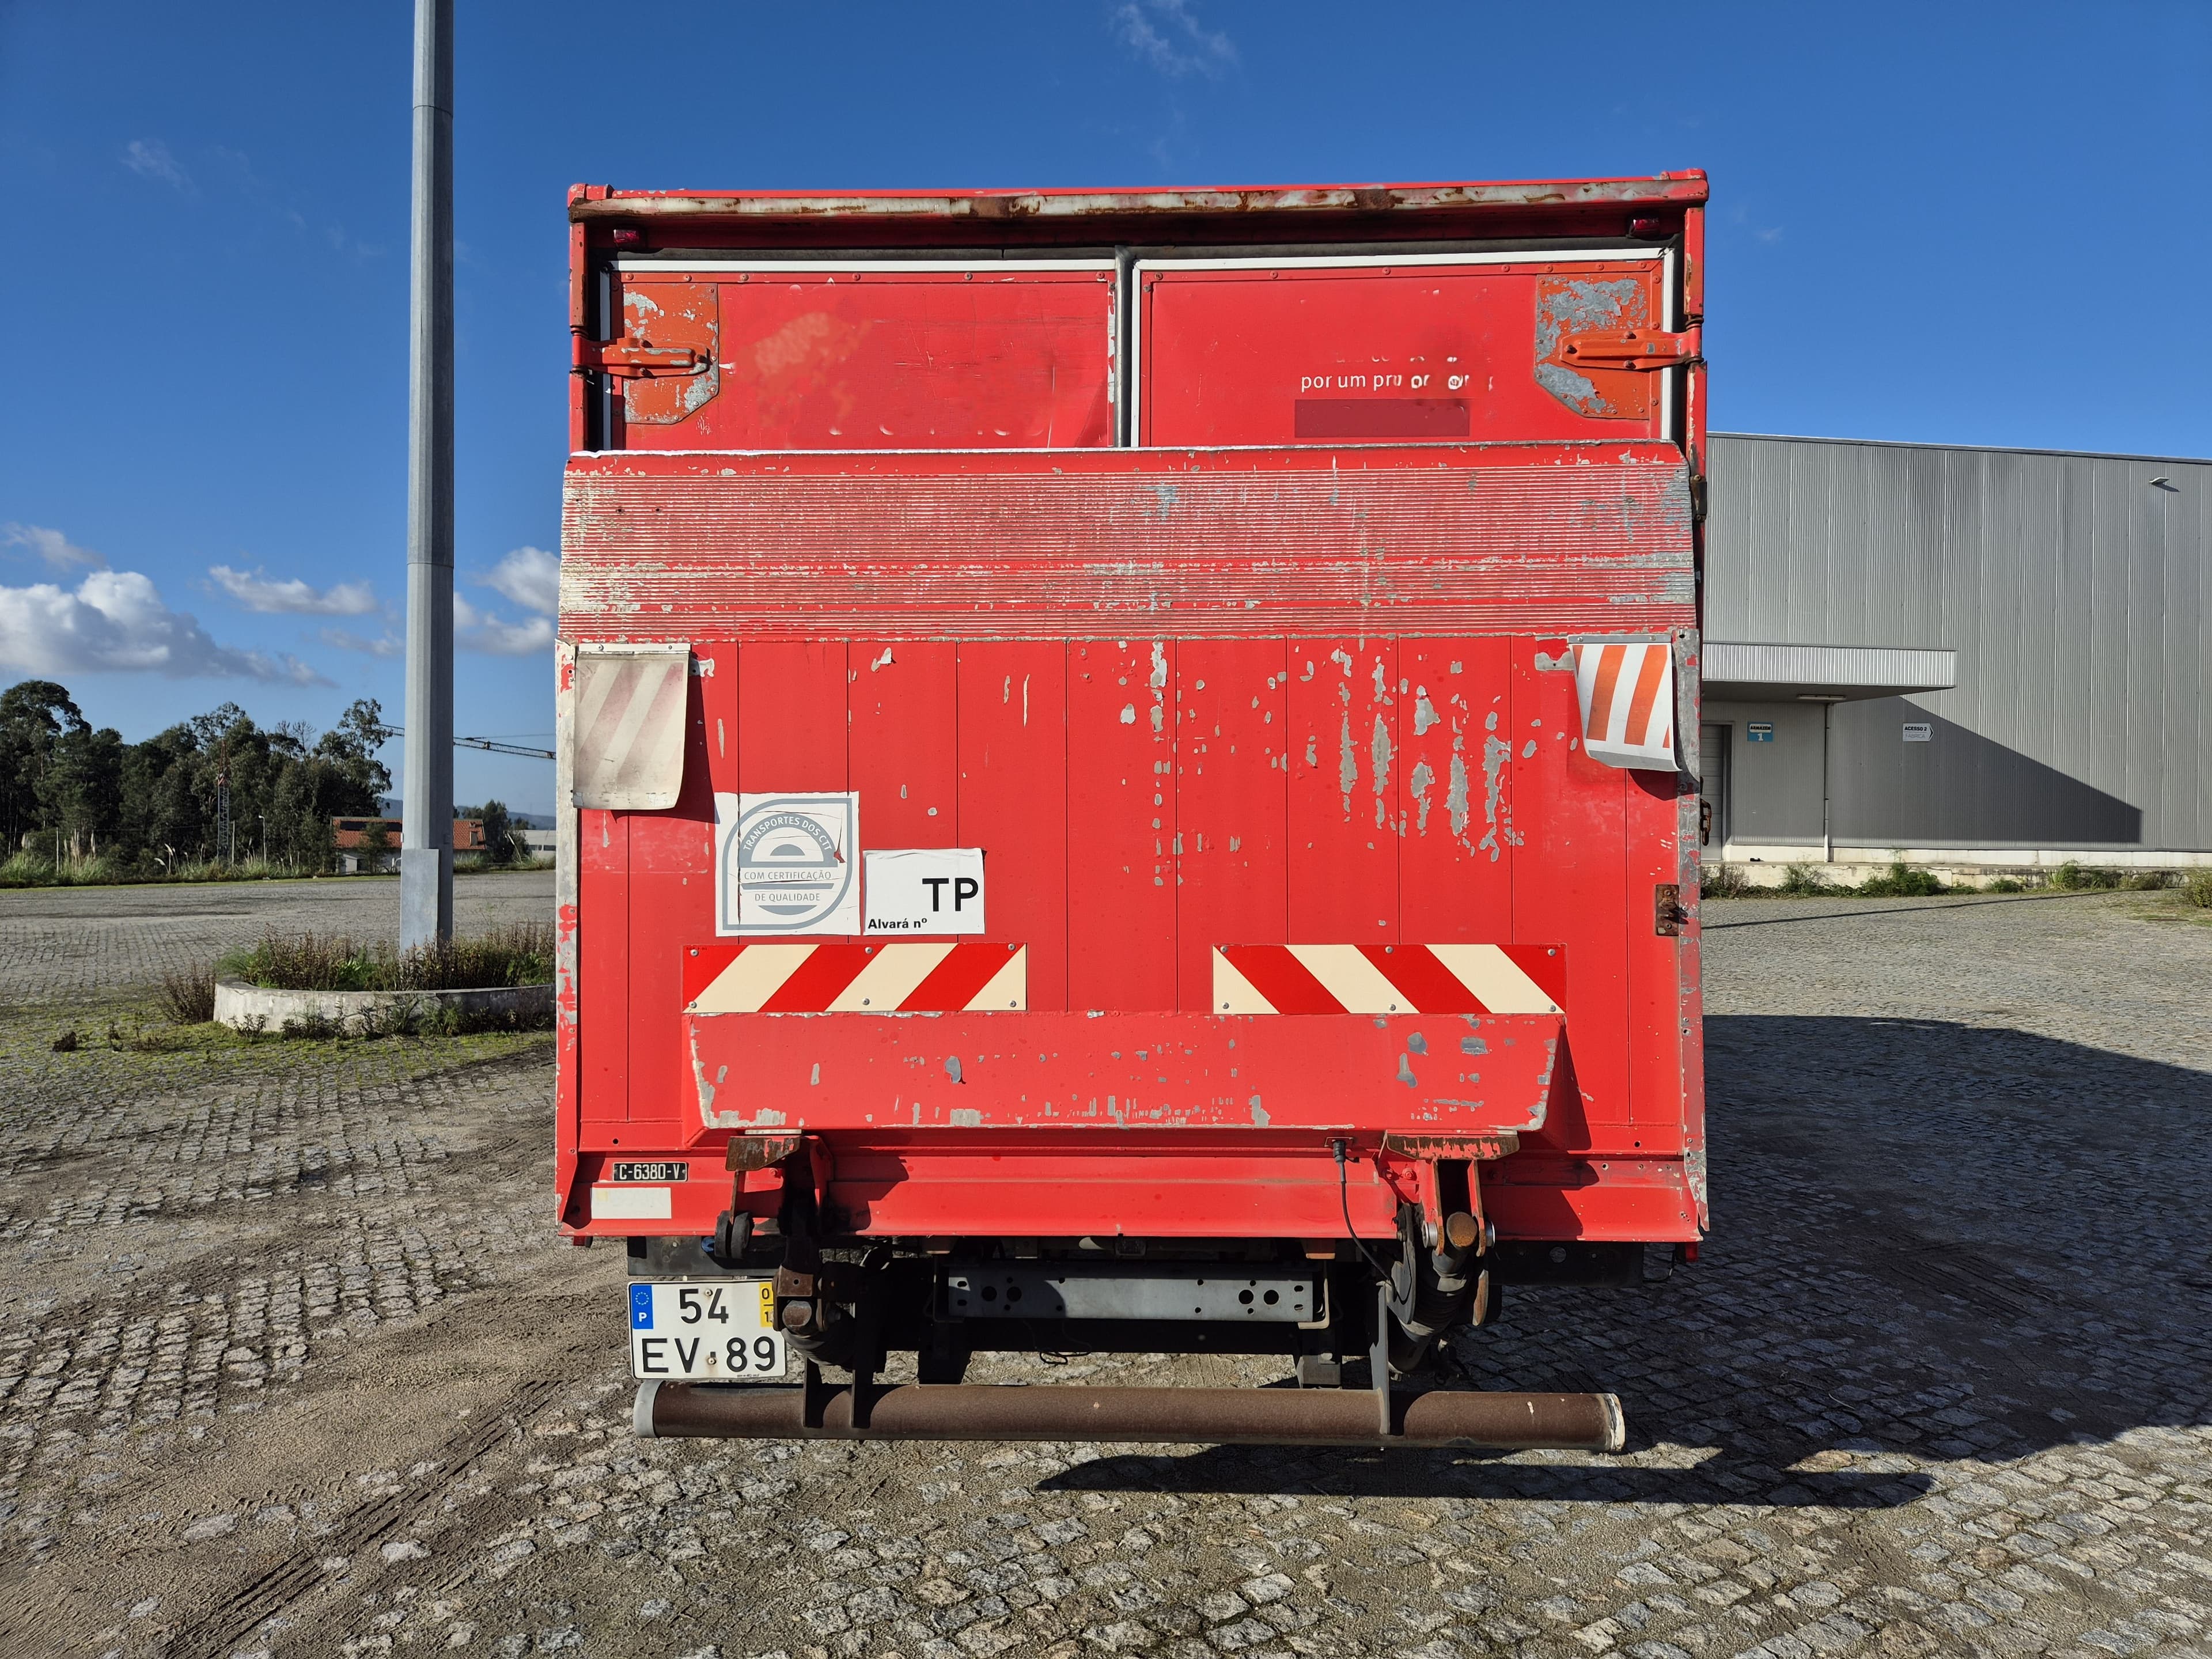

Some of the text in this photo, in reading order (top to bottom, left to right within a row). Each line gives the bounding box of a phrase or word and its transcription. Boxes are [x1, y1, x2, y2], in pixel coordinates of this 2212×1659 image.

[1301, 376, 1332, 393] por
[1338, 375, 1366, 388] um
[1758, 733, 1764, 741] 1
[743, 816, 832, 851] TRANSPORTES DOS CTT
[744, 870, 831, 881] COM CERTIFICAÇÃO
[755, 893, 820, 903] DE QUALIDADE
[922, 877, 979, 912] TP
[868, 918, 909, 929] Alvará
[619, 1164, 680, 1180] C-6380-V
[679, 1288, 729, 1324] 54
[638, 1312, 647, 1322] P
